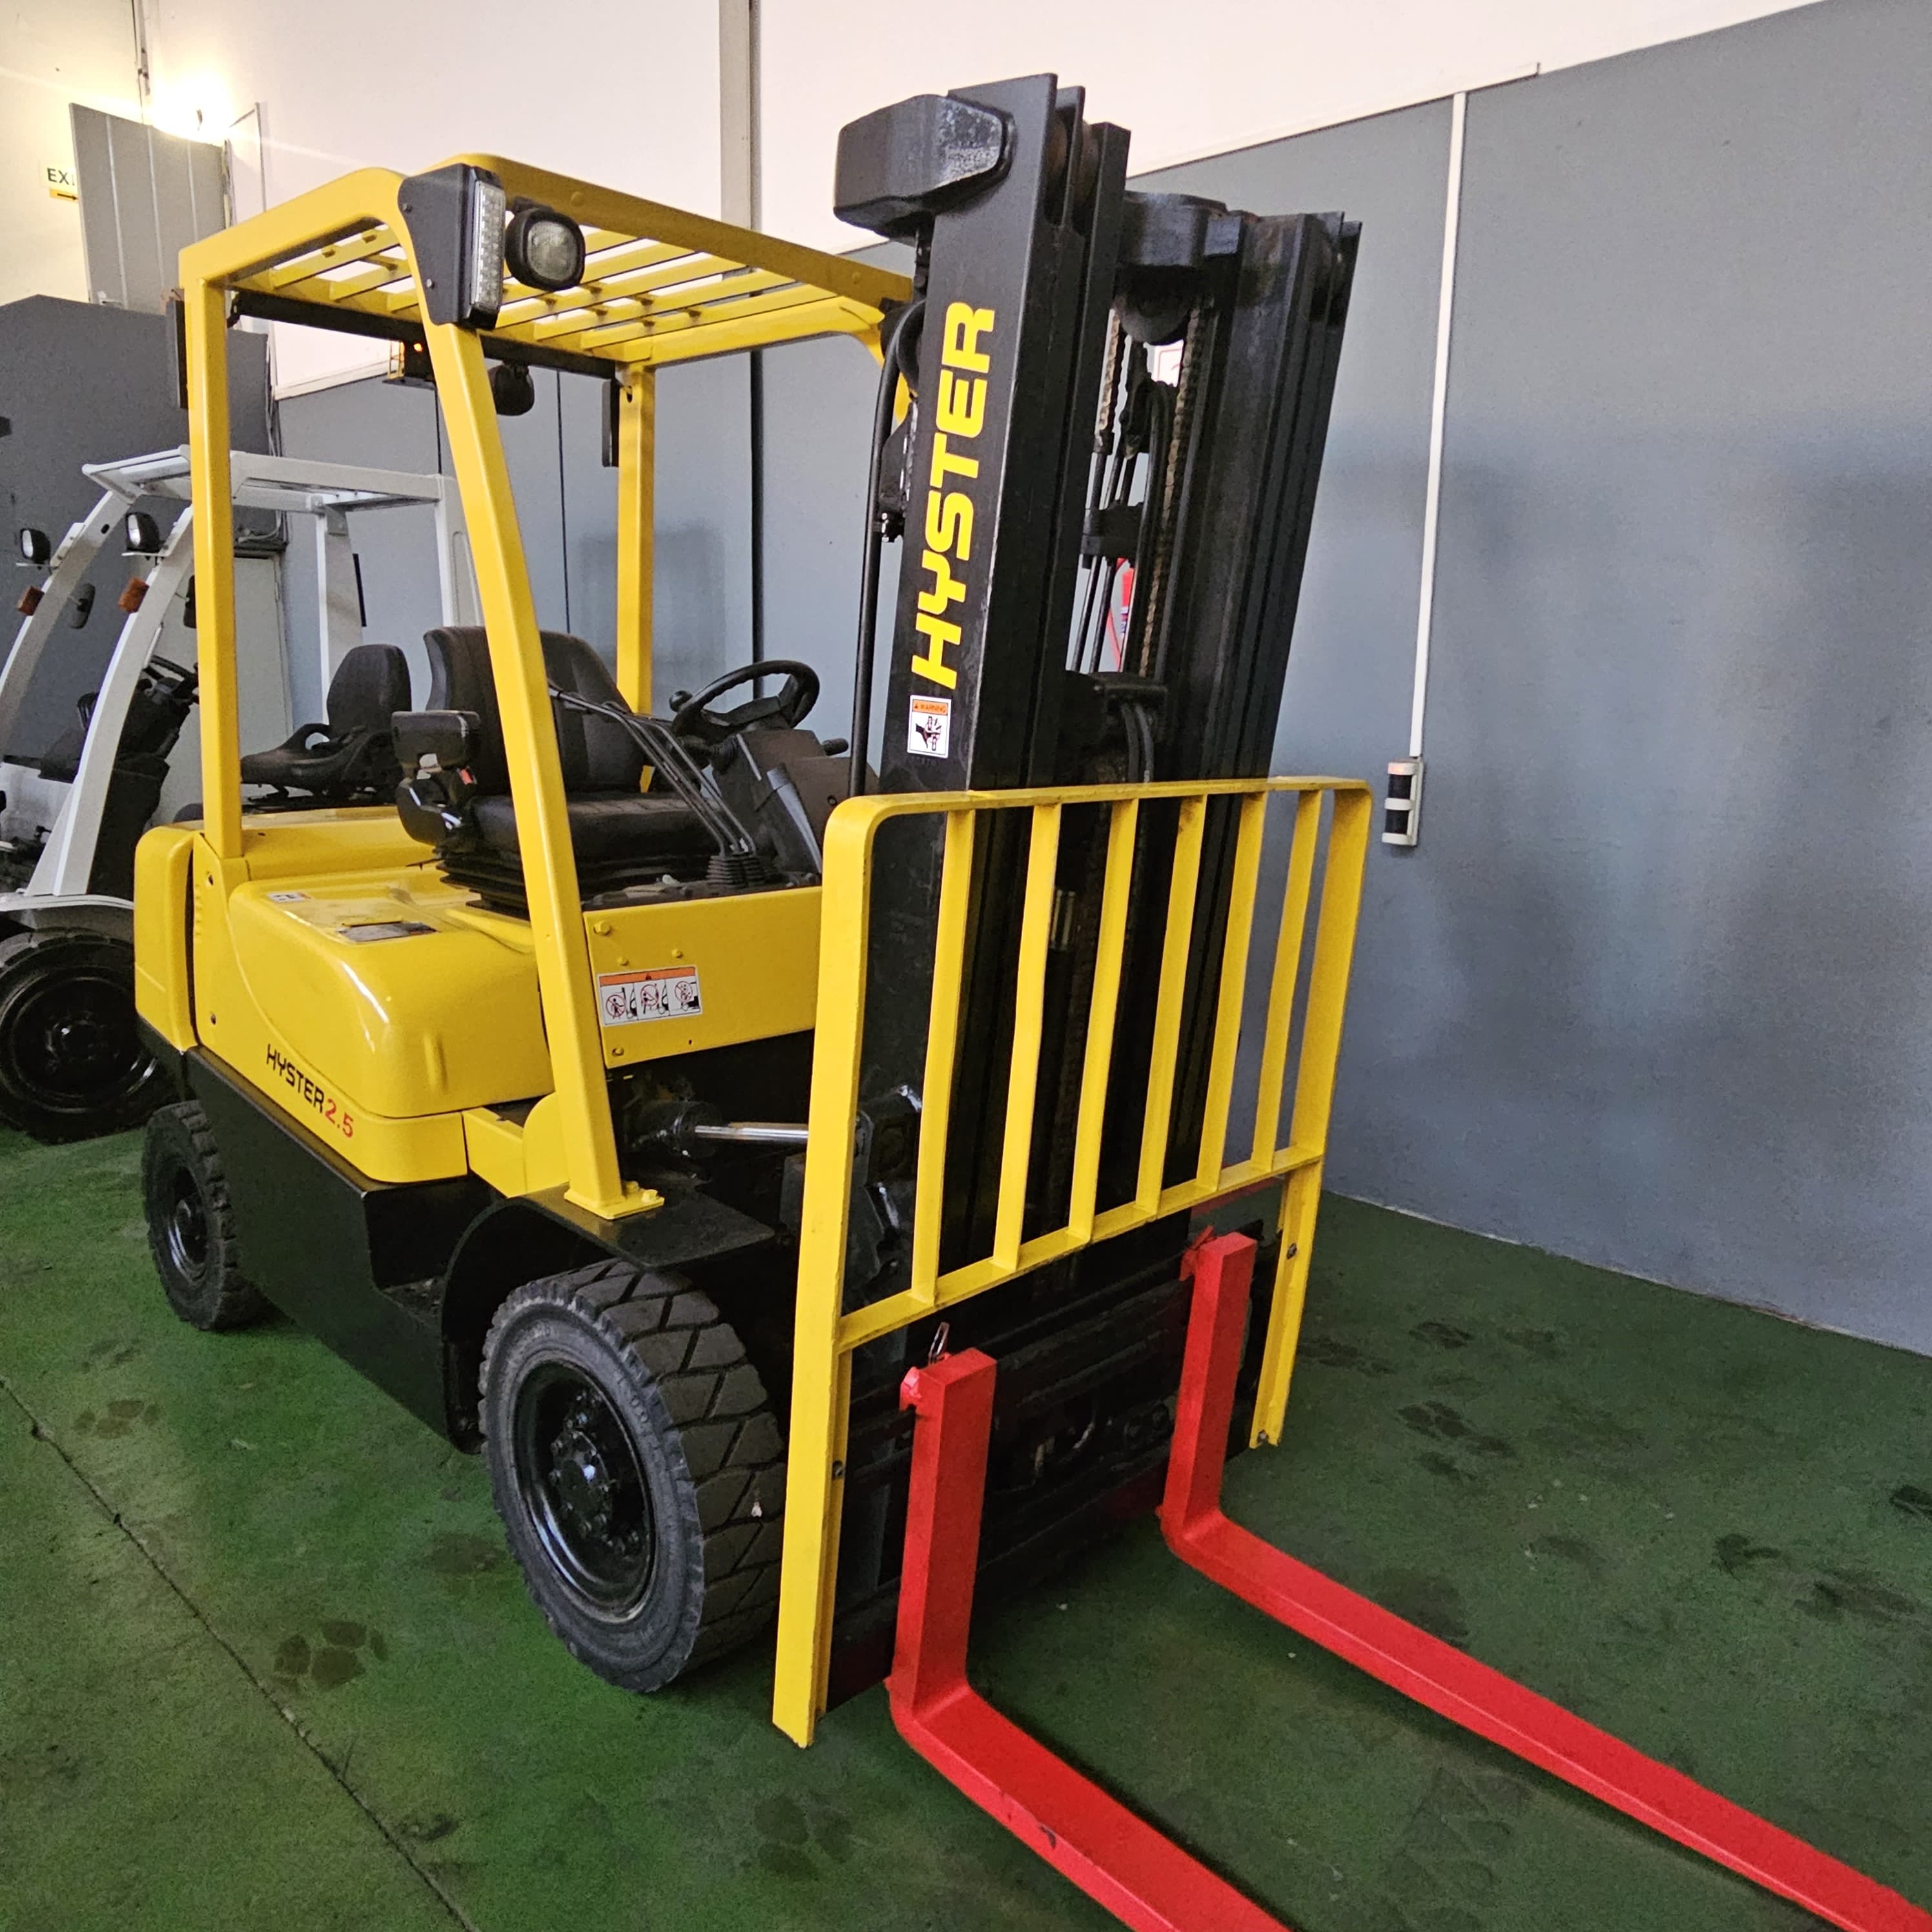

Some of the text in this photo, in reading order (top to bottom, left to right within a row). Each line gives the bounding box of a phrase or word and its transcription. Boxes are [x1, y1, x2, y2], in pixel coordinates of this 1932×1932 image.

[46, 167, 76, 186] EXI
[910, 301, 996, 690] HYSTER
[266, 1043, 354, 1138] HYSTER 2.5
